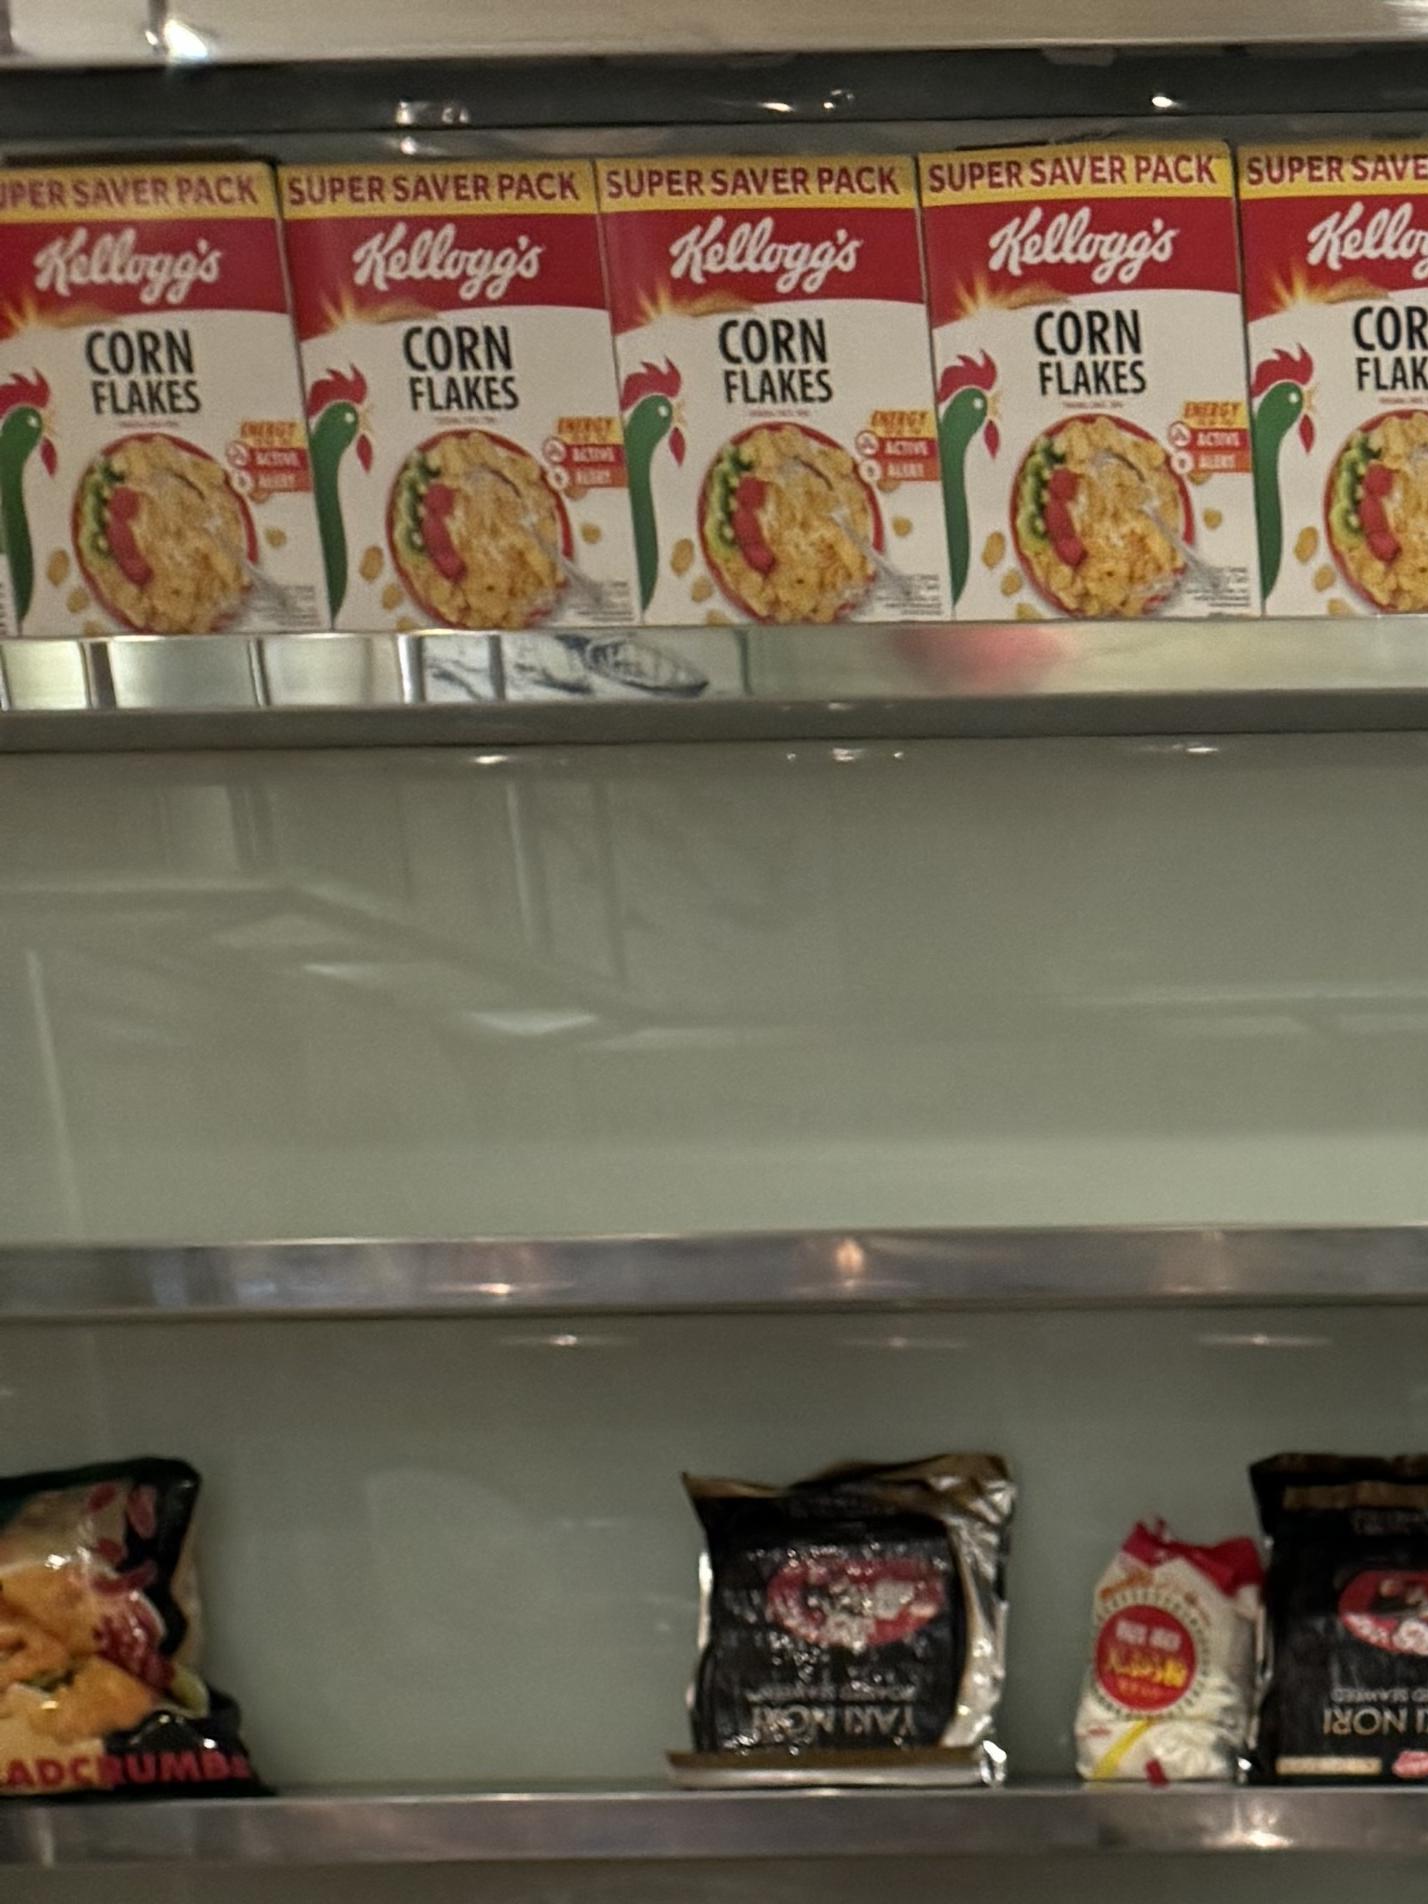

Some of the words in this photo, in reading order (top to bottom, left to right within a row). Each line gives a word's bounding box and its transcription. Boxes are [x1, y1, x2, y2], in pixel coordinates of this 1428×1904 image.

[289, 171, 386, 203] SUPER
[393, 171, 490, 201] SAVER
[497, 170, 578, 200] PACK
[606, 168, 701, 200] SUPER
[711, 167, 809, 196] SAVER
[816, 164, 900, 194] PACK
[928, 160, 1023, 192] SUPER
[1029, 157, 1127, 188] SAVER
[1134, 153, 1216, 185] PACK
[1247, 154, 1343, 186] SUPER
[72, 176, 168, 207] SAVER
[176, 174, 258, 205] PACK
[352, 222, 544, 299] Kellogg's
[669, 215, 863, 293] Kellogg's
[989, 206, 1179, 284] Kellogg's
[33, 227, 222, 305] Kellogg's
[85, 328, 195, 376] CORN
[402, 324, 513, 373] CORN
[718, 317, 829, 365] CORN
[1034, 309, 1142, 357] CORN
[92, 379, 202, 415] FLAKES
[409, 374, 520, 413] FLAKES
[724, 368, 834, 404] FLAKES
[1038, 359, 1147, 396] FLAKES
[1322, 1707, 1407, 1735] NORI
